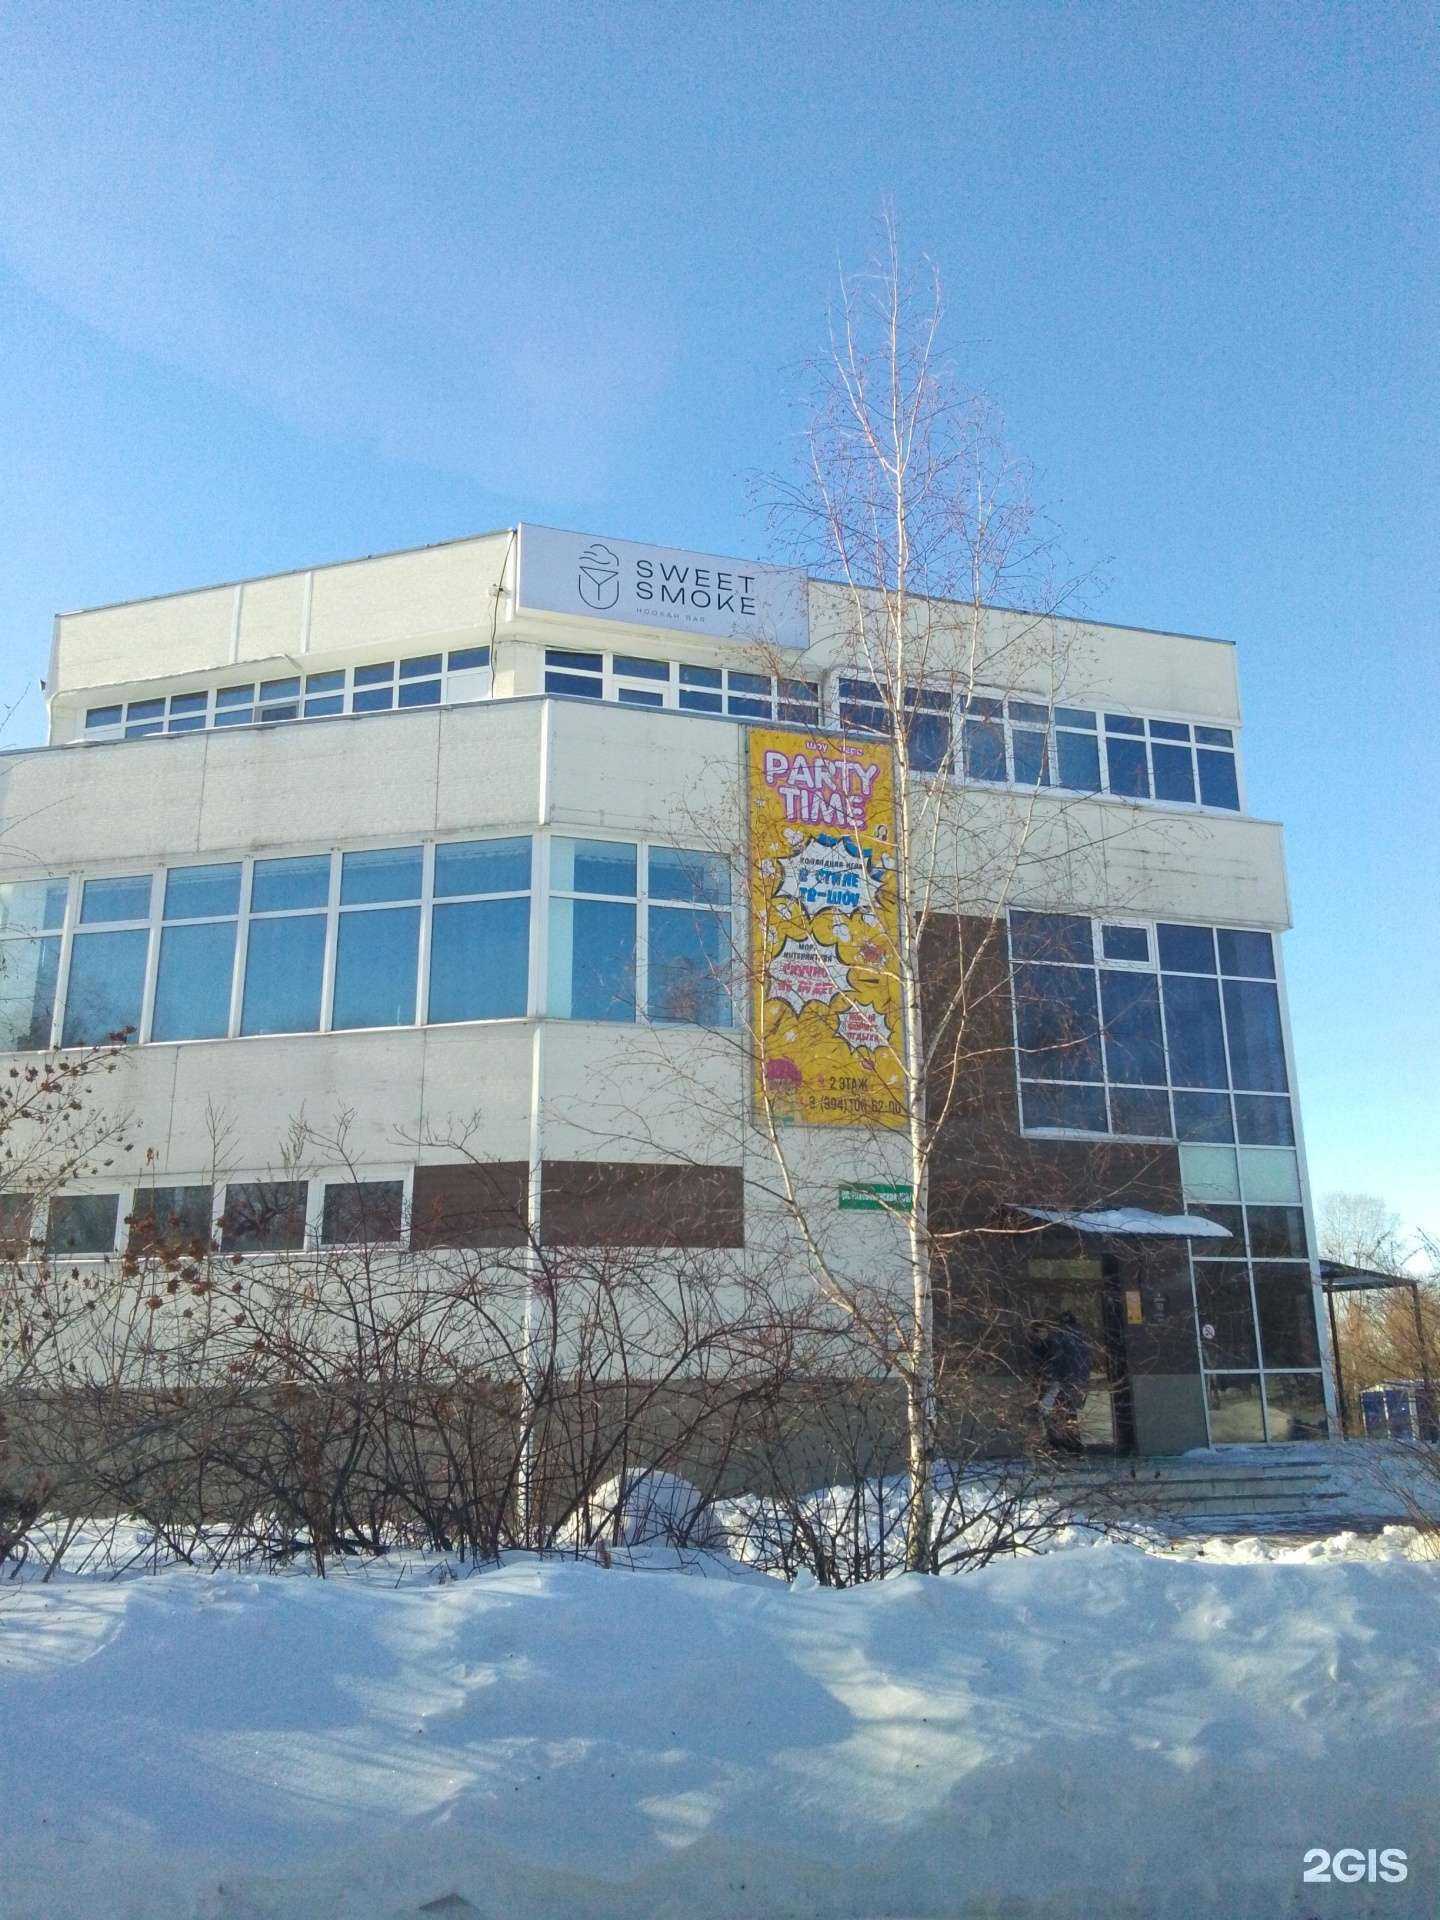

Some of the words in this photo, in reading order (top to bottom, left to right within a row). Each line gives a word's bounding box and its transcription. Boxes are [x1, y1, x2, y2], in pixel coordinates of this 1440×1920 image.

[636, 559, 756, 594] SWEET
[636, 581, 756, 616] SMOKE
[764, 750, 880, 796] PARTY
[777, 786, 867, 830] TIME
[830, 1076, 837, 1090] 2
[839, 1076, 869, 1091] ЭТАЖ
